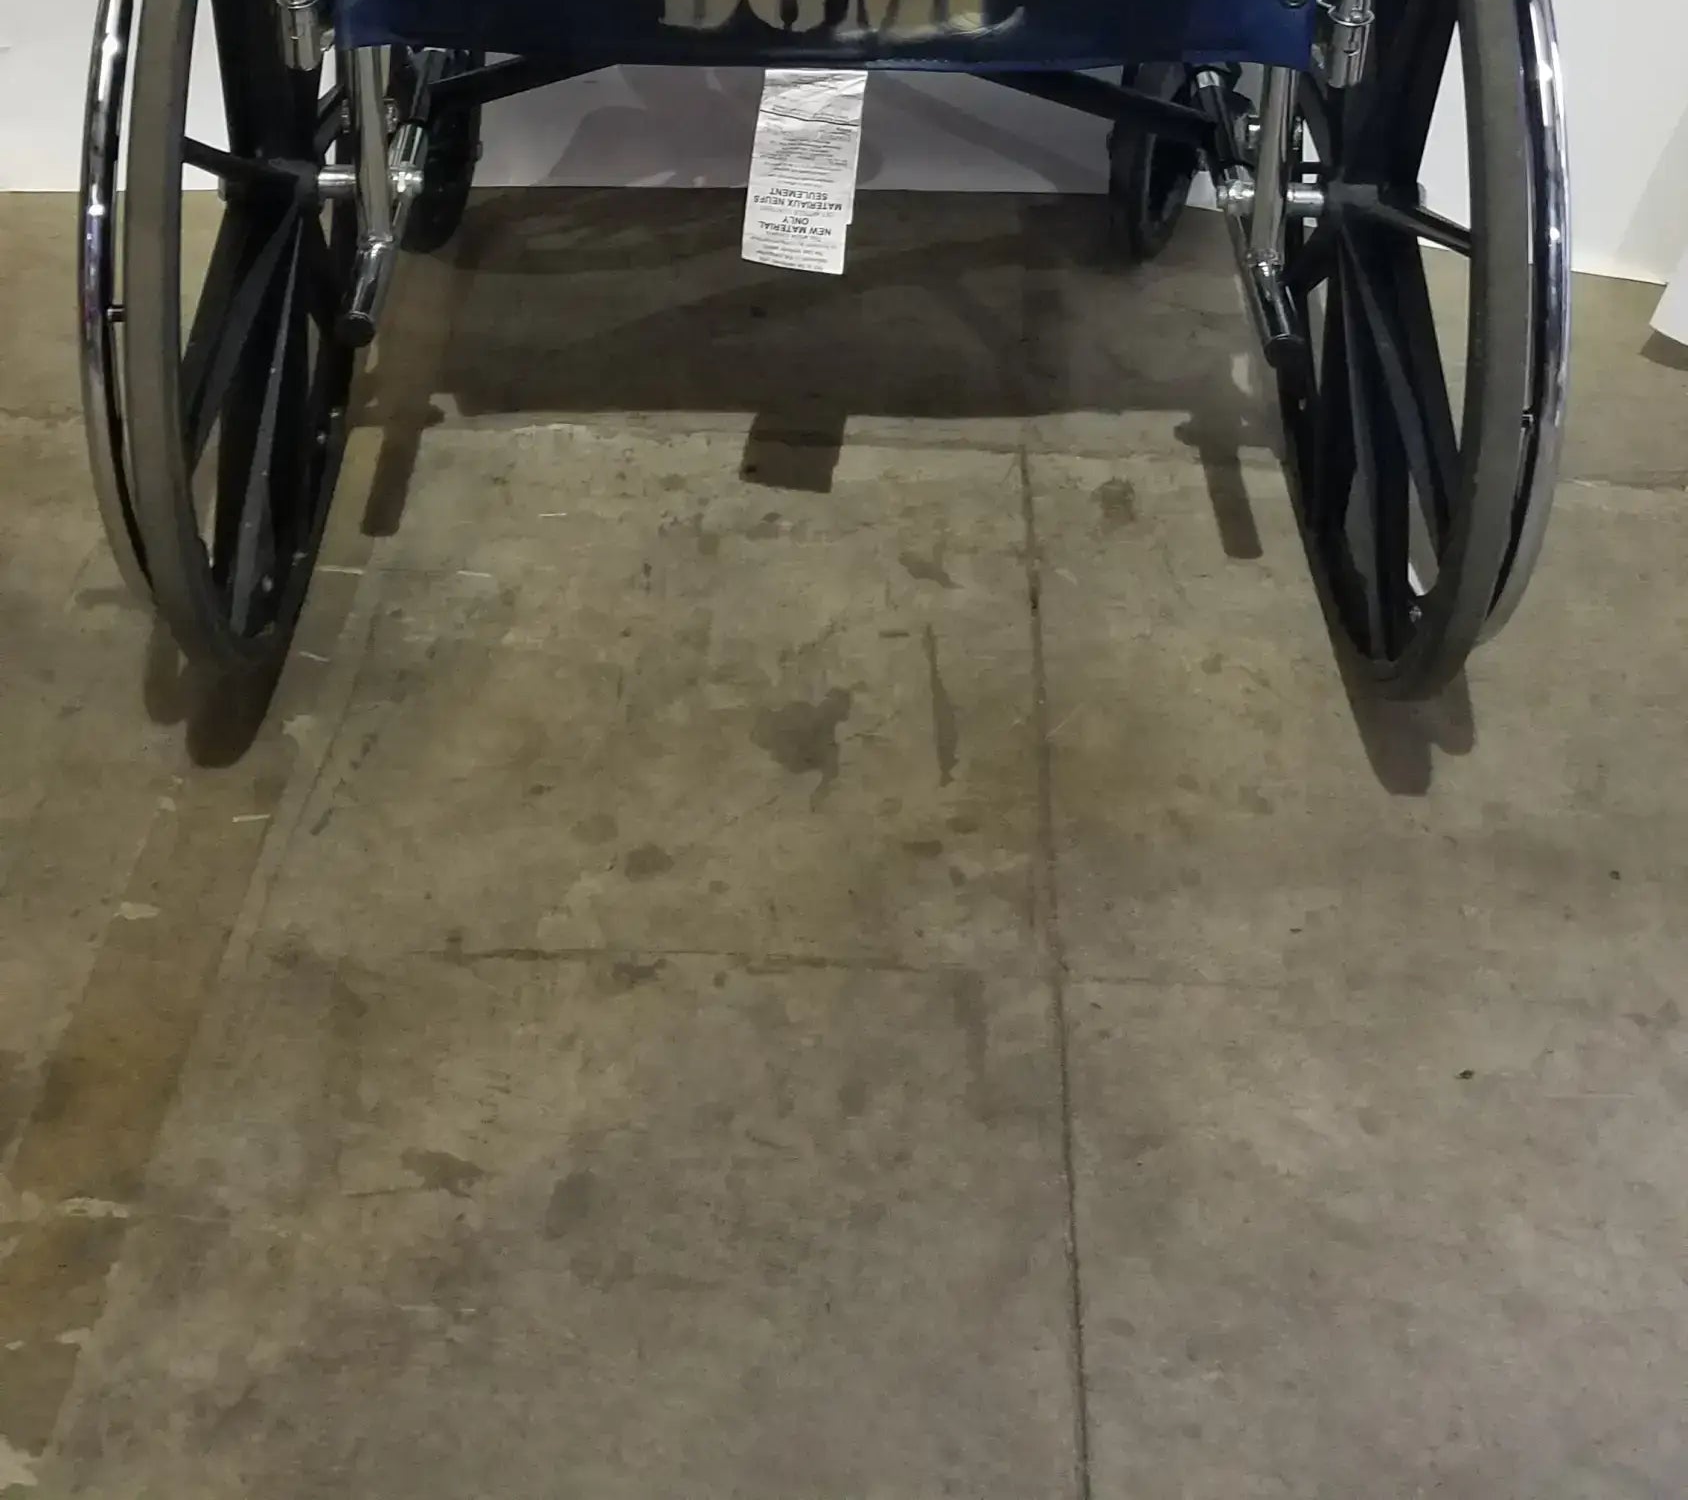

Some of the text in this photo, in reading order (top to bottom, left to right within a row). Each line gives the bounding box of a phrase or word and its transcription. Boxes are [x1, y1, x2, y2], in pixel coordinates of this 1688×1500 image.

[770, 188, 828, 200] SEULEMENT
[754, 195, 784, 204] NEUFS
[783, 216, 809, 225] ONLY
[758, 221, 831, 236] NEW MATERIAL
